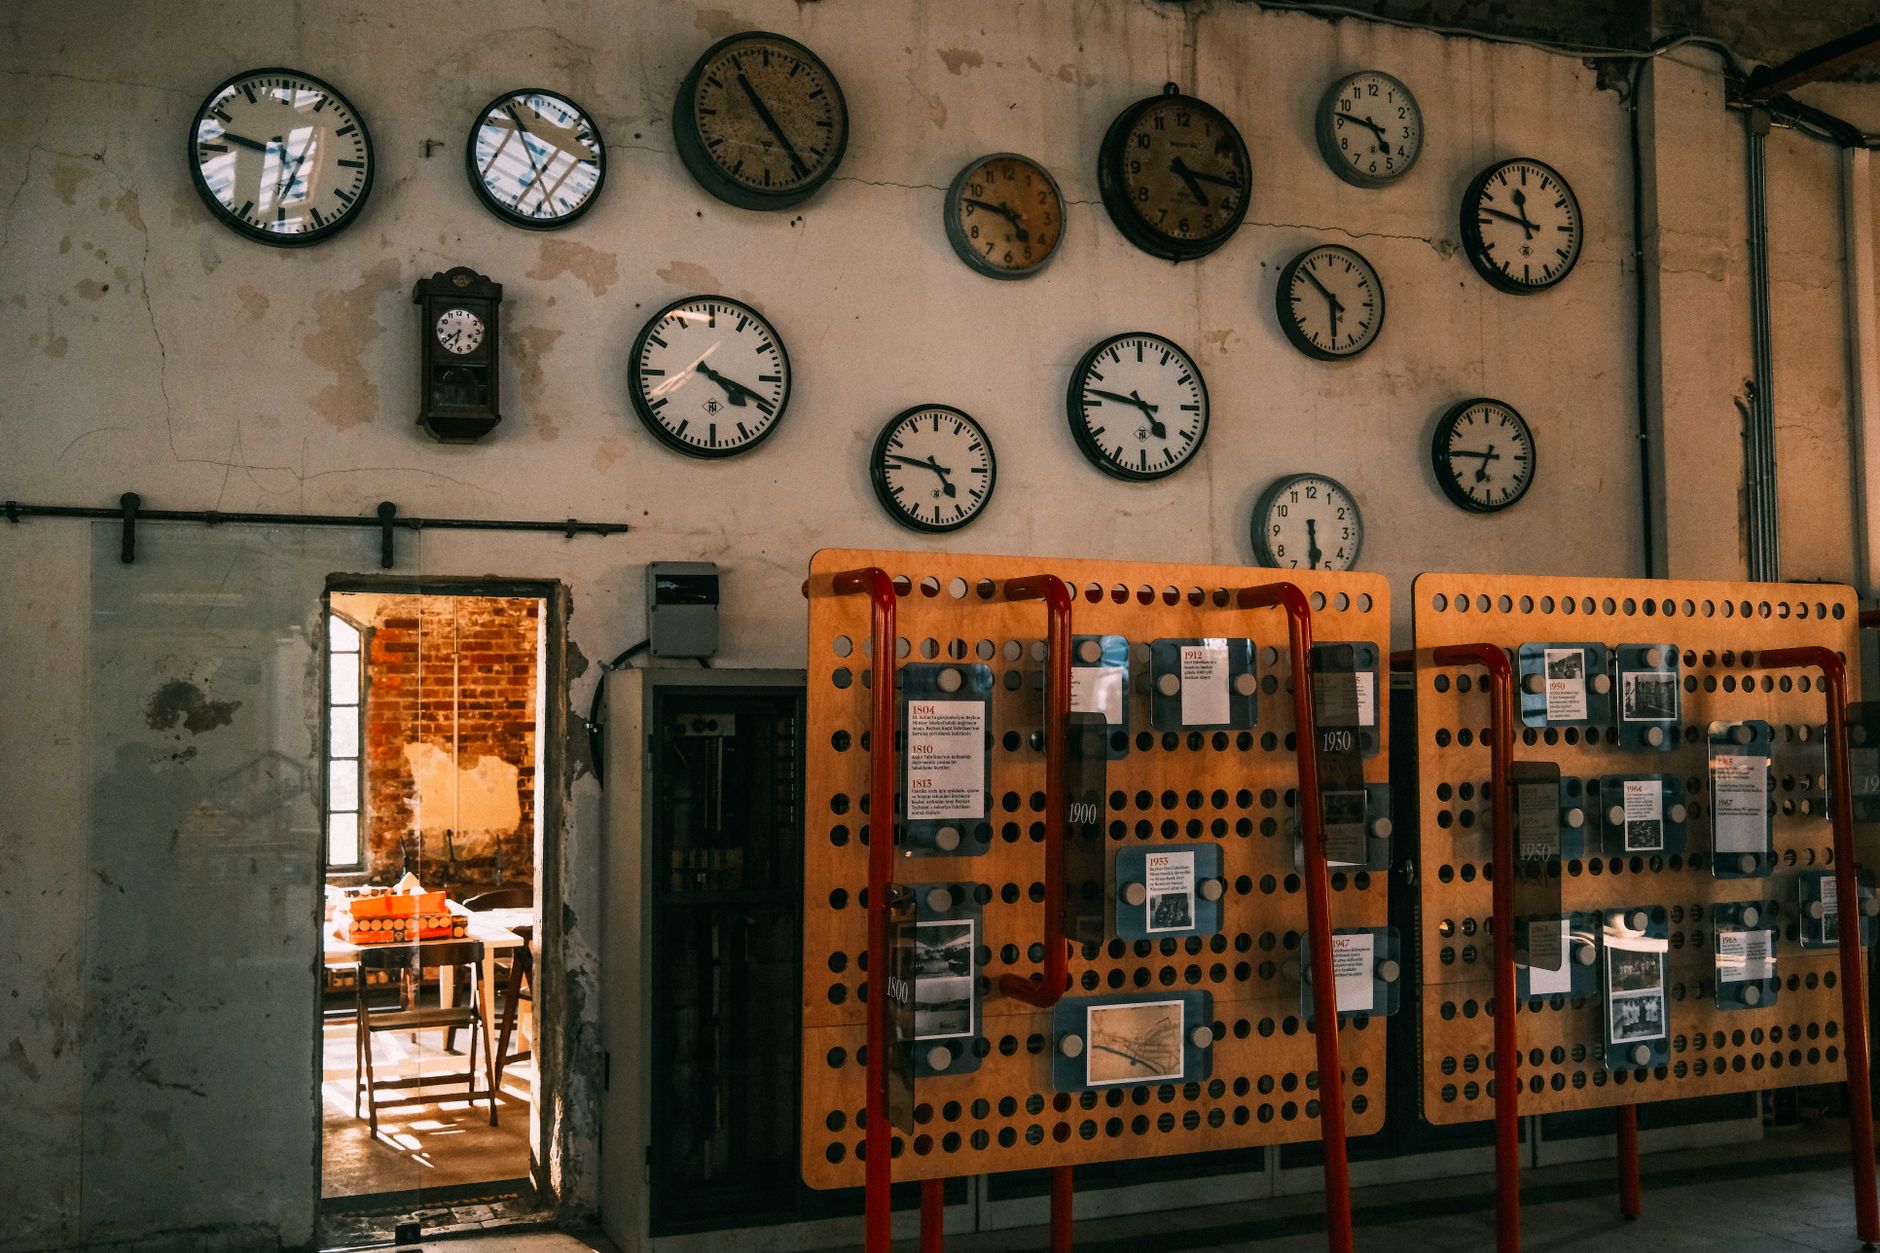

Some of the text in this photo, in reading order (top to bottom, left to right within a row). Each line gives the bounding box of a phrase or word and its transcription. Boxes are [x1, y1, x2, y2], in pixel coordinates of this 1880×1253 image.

[1353, 87, 1360, 99] 11
[1368, 84, 1379, 96] 12
[1388, 92, 1392, 104] 1
[1341, 99, 1351, 112] 10
[1398, 107, 1405, 119] 2
[1154, 117, 1164, 130] 11
[1177, 112, 1190, 127] 12
[1337, 118, 1344, 130] 9
[1206, 123, 1210, 136] 1
[1402, 126, 1409, 139] 3
[1138, 133, 1150, 149] 10
[1341, 138, 1348, 150] 8
[1397, 145, 1404, 157] 4
[1353, 153, 1360, 165] 7
[1386, 158, 1393, 170] 5
[1002, 165, 1015, 180] 12
[1131, 160, 1140, 174] 9
[1369, 161, 1377, 173] 6
[985, 170, 995, 184] 11
[970, 184, 982, 197] 10
[1138, 187, 1148, 201] 8
[1039, 192, 1046, 204] 2
[1220, 196, 1230, 210] 4
[966, 205, 974, 216] 9
[1158, 209, 1168, 224] 7
[1043, 212, 1051, 226] 3
[1179, 218, 1190, 232] 6
[1204, 214, 1213, 228] 5
[971, 225, 979, 239] 8
[1038, 233, 1046, 245] 4
[986, 243, 994, 255] 7
[1024, 246, 1032, 260] 5
[1004, 250, 1013, 263] 6
[1290, 491, 1298, 503] 11
[1306, 486, 1317, 499] 12
[1327, 493, 1331, 505] 1
[1277, 505, 1288, 517] 10
[1337, 507, 1345, 520] 2
[1273, 524, 1280, 536] 9
[1342, 527, 1349, 540] 3
[1277, 544, 1285, 557] 8
[1336, 547, 1344, 559] 4
[1290, 560, 1298, 569] 7
[1325, 561, 1331, 571] 5
[1185, 651, 1202, 660] 1912
[1549, 682, 1565, 690] 1950
[912, 705, 935, 714] 1804
[912, 745, 933, 753] 1810
[912, 779, 932, 788] 1813
[1627, 785, 1642, 793] 1964
[1864, 775, 1880, 793] 19
[1068, 802, 1096, 825] 1900
[886, 976, 908, 1004] 1800
